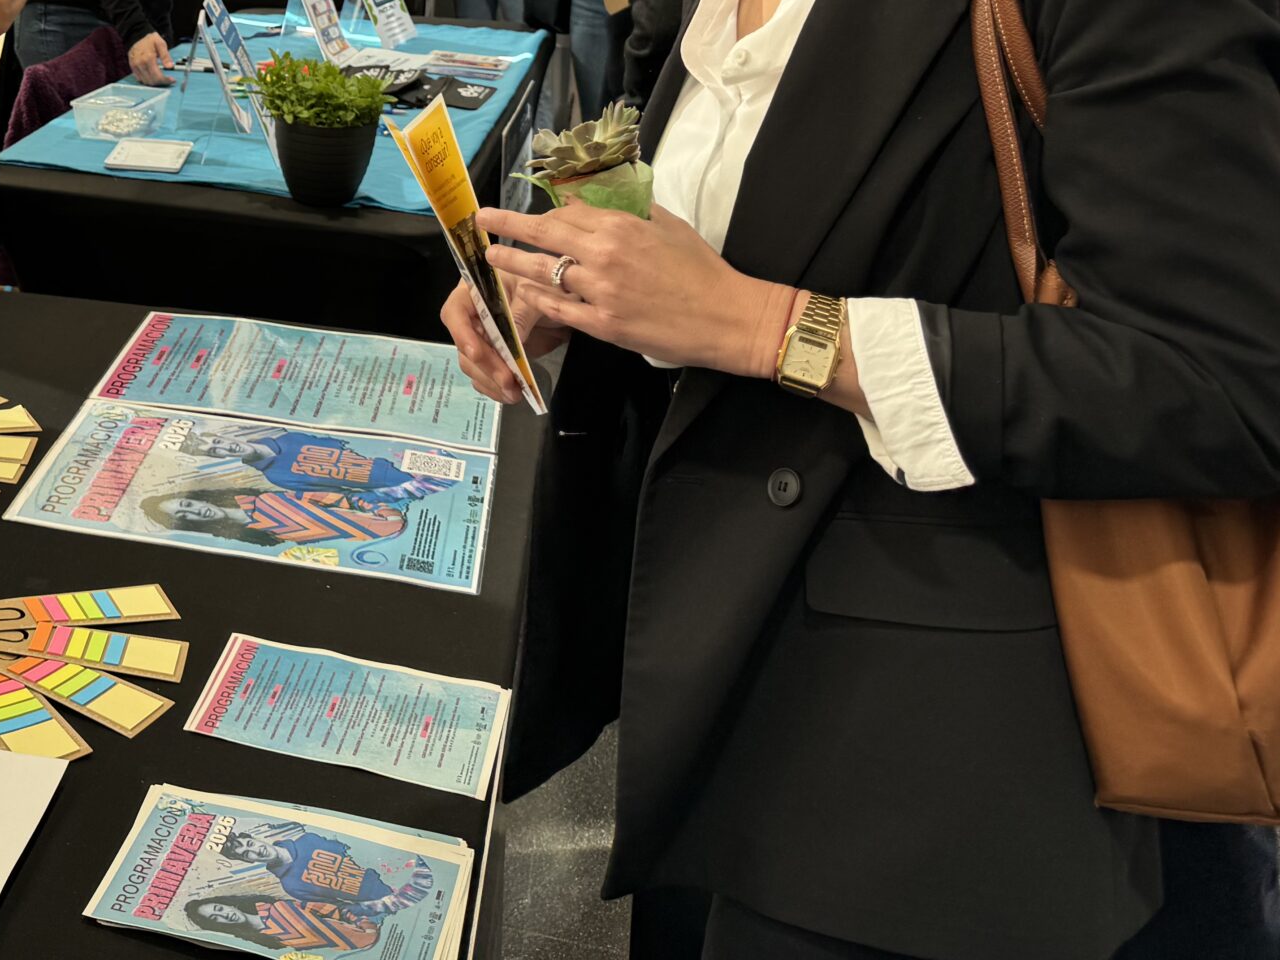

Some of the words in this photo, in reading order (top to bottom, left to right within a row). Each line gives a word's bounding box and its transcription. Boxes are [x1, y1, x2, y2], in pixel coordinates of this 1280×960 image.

[106, 314, 174, 399] PROGRAMACIÓN
[41, 408, 127, 515] PROGRAMACIÓN
[71, 416, 169, 522] PRIMAVERA
[158, 419, 196, 452] 2026
[205, 642, 260, 730] PROGRAMACIÓN
[111, 805, 180, 913] PROGRAMACIÓN
[132, 811, 217, 920] PRIMAVERA
[205, 816, 237, 852] 2026
